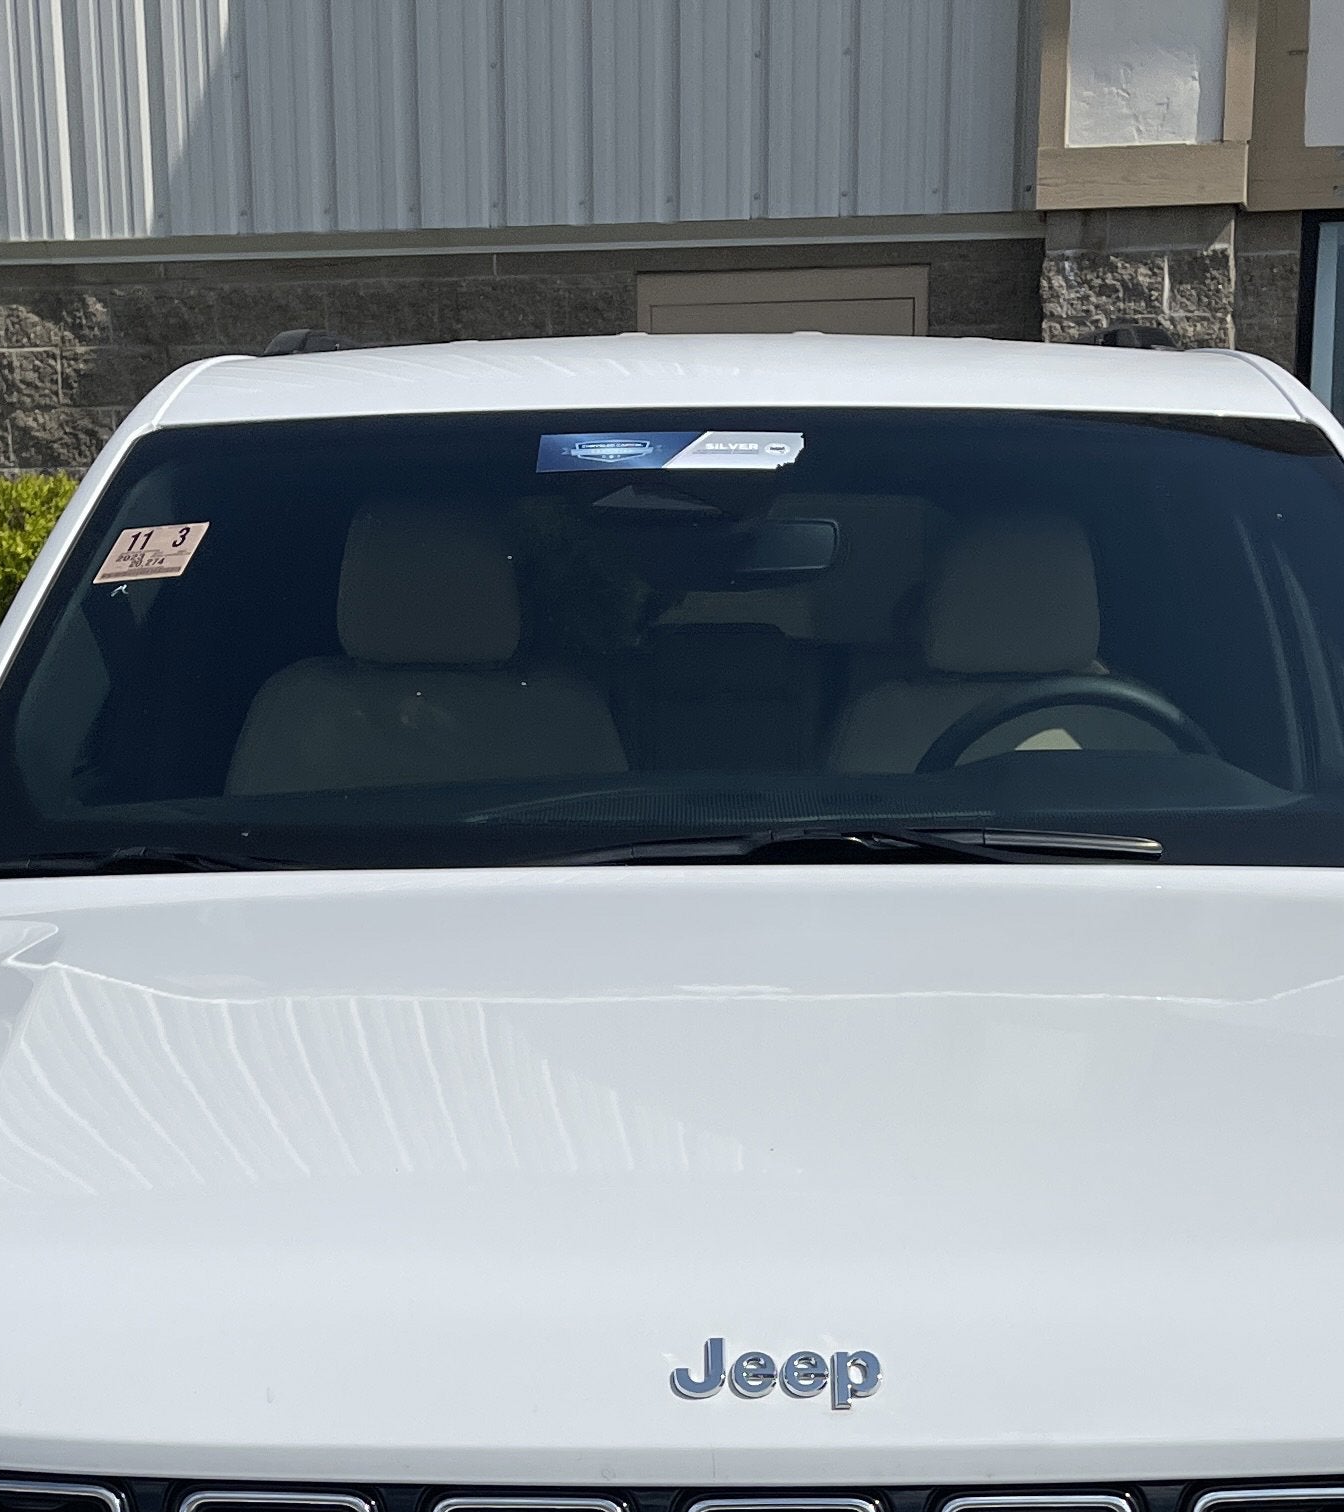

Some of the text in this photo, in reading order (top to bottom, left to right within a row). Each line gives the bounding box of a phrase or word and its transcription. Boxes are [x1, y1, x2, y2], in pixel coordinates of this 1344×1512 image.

[127, 527, 191, 551] 11 3
[670, 1337, 883, 1411] Jeep
